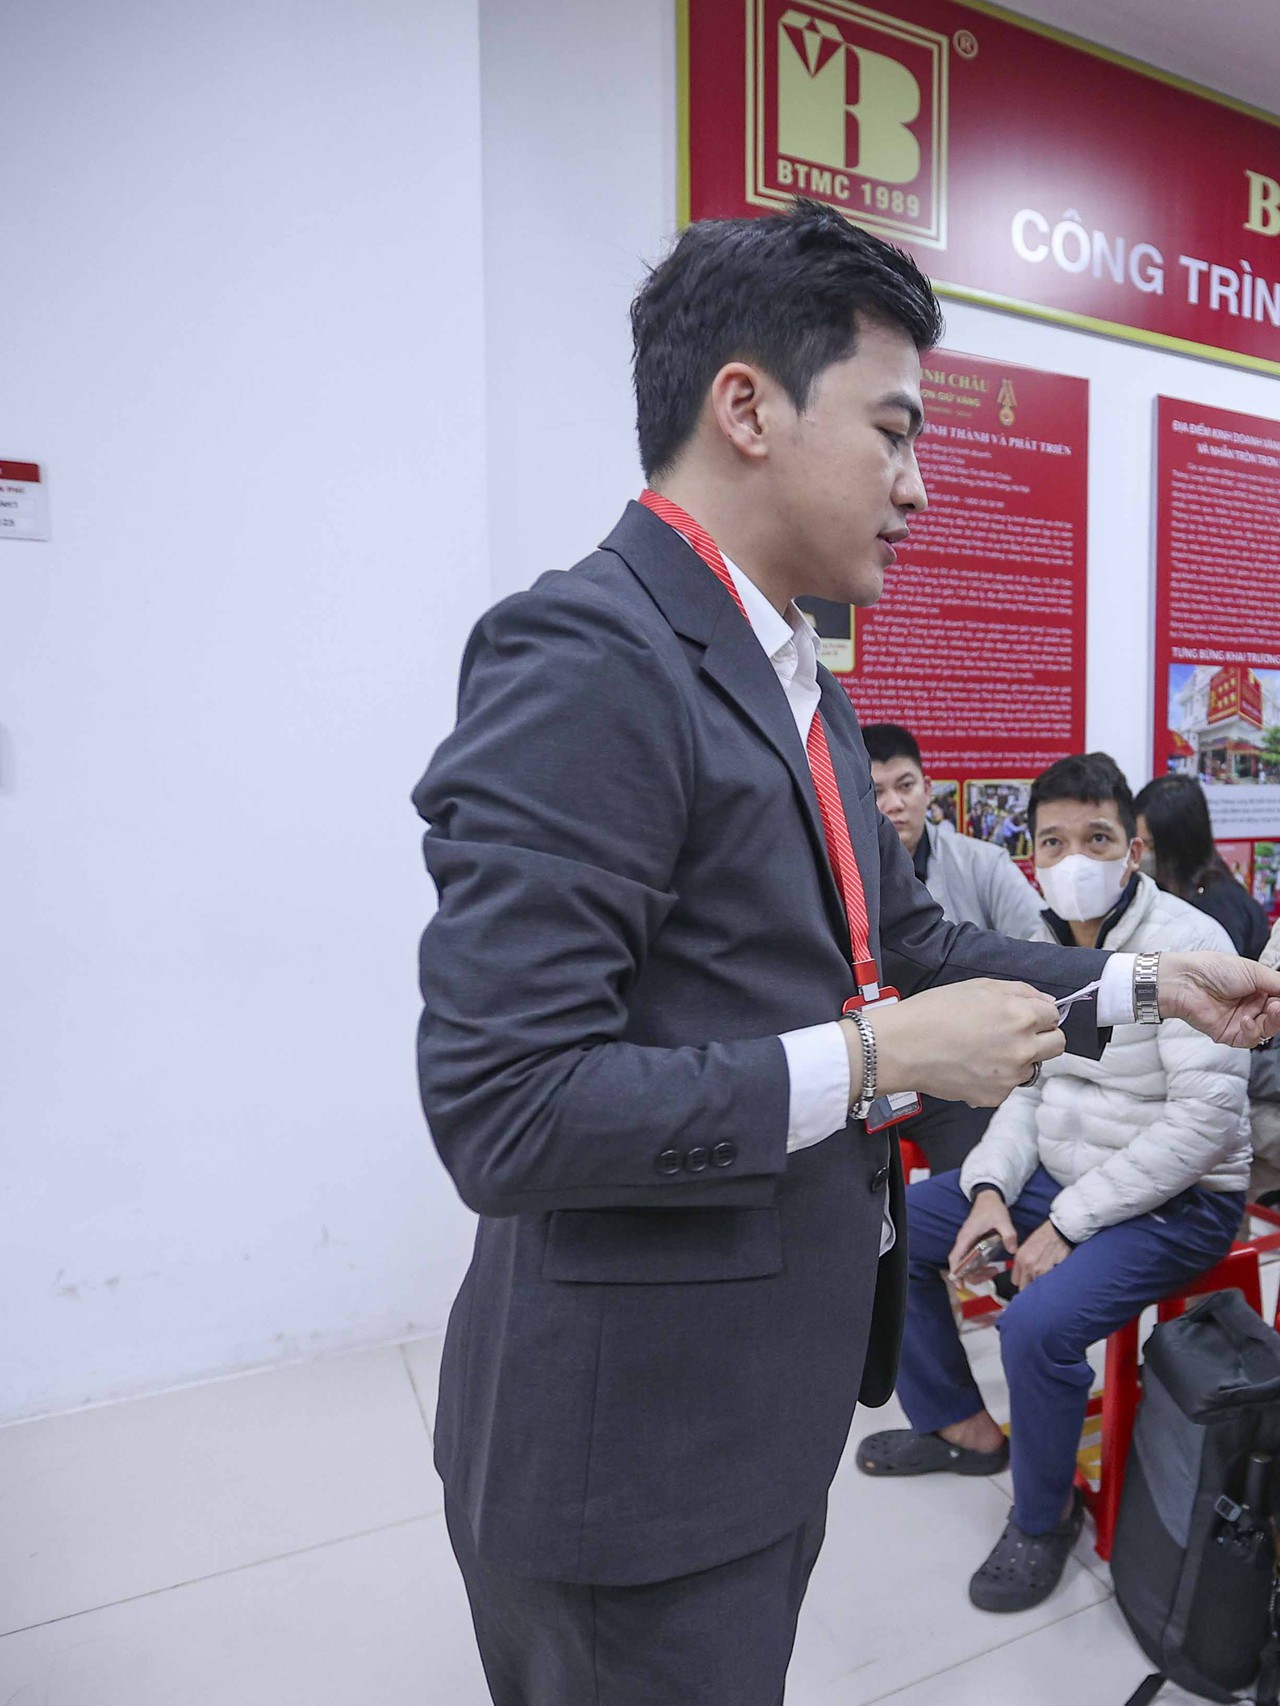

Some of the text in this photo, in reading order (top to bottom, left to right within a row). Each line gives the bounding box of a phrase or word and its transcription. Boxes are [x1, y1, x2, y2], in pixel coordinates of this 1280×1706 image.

[777, 158, 920, 218] BTMC 1989
[1011, 208, 1164, 296] CÔNG
[920, 368, 945, 385] INH
